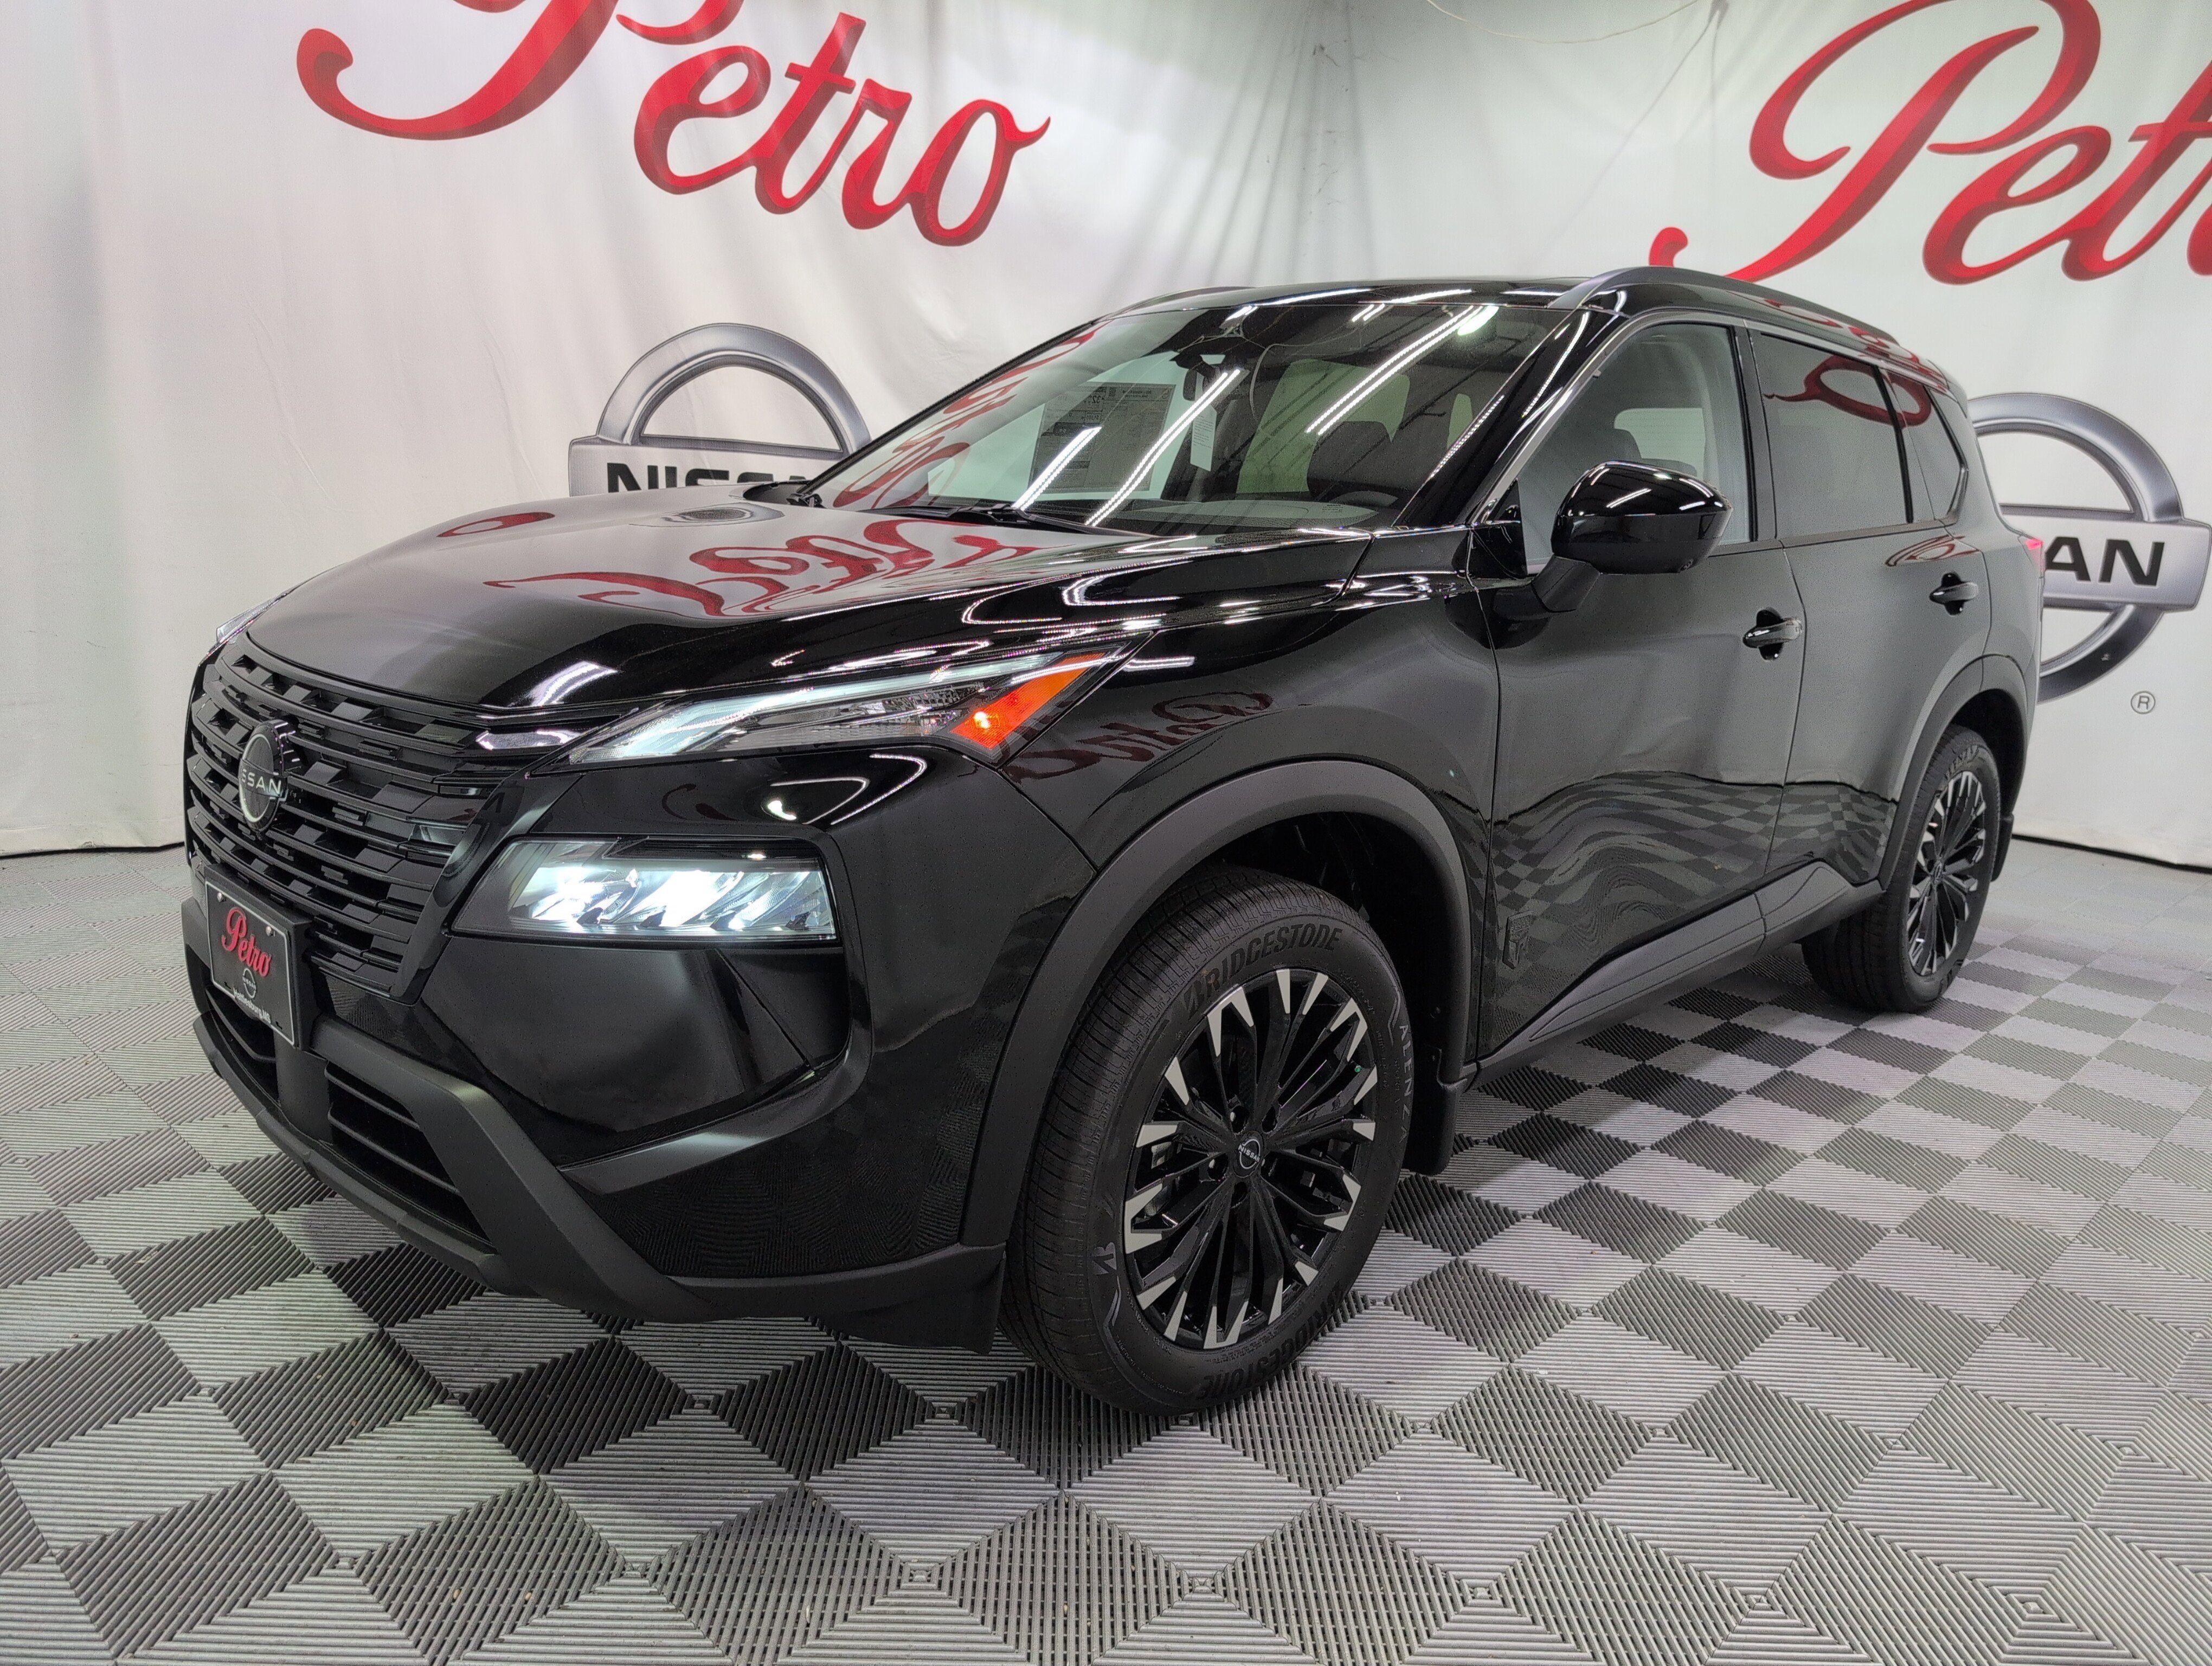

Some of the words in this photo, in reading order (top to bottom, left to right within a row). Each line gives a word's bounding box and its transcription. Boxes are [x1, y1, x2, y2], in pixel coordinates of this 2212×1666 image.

[1649, 0, 2212, 285] Pet
[241, 768, 281, 795] SSAN
[221, 907, 272, 977] Petro
[1183, 922, 1343, 1021] BRIDGESTONE
[1399, 1024, 1413, 1143] ALENZA
[1238, 1144, 1261, 1163] NISSAN
